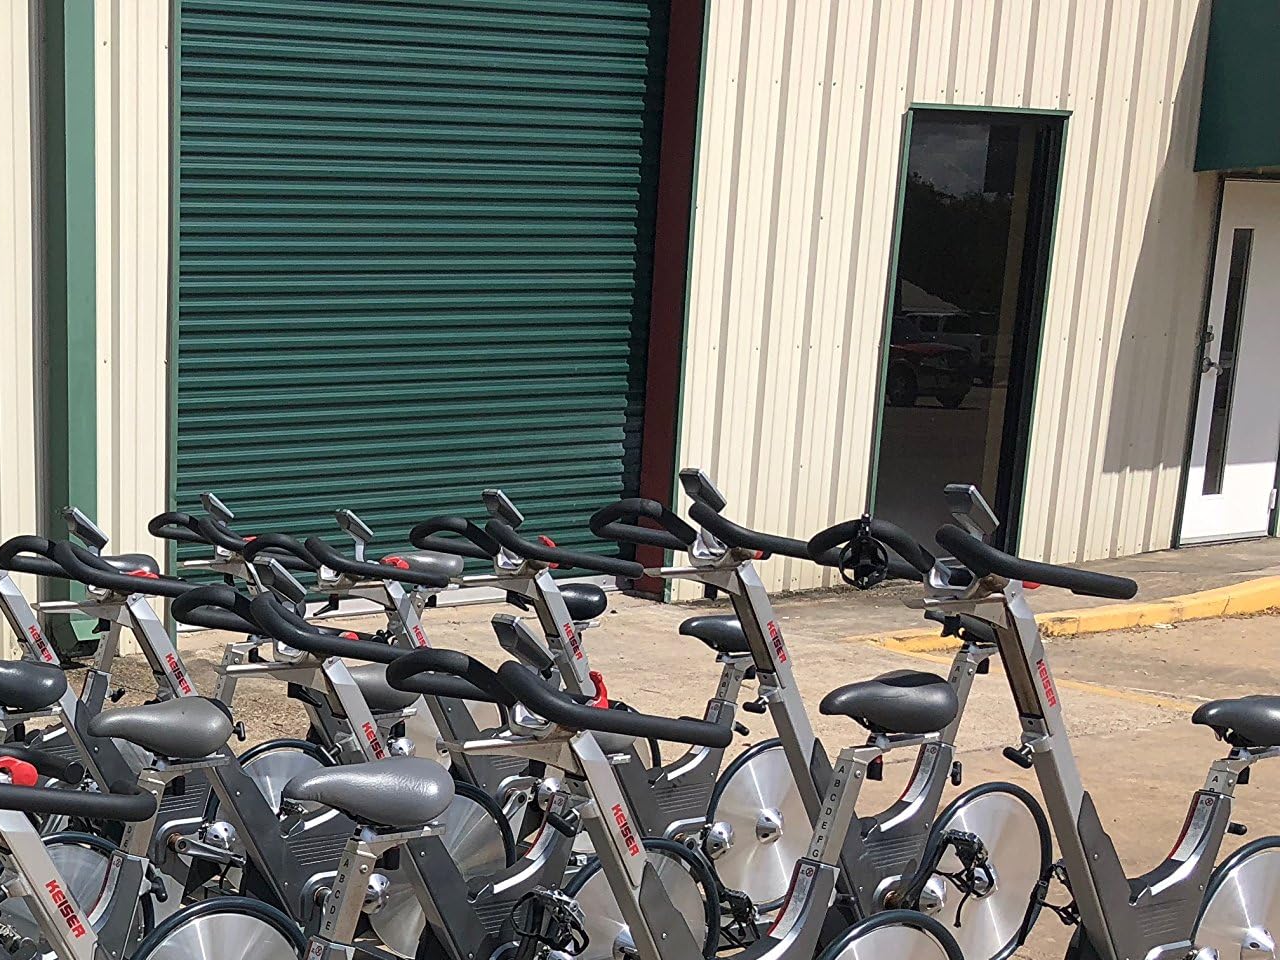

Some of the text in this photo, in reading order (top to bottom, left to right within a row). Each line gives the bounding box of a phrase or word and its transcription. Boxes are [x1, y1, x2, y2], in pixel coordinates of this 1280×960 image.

[28, 624, 53, 663] KEISER
[563, 622, 584, 661] KEISER
[767, 620, 787, 664] KEISER
[165, 652, 192, 695] KEISER
[1036, 658, 1057, 708] KEISER
[361, 721, 386, 760] KEISE
[834, 779, 841, 788] B
[838, 765, 845, 774] A
[825, 807, 832, 816] D
[830, 793, 837, 802] C
[610, 803, 640, 857] KEISER
[821, 821, 828, 830] E
[45, 879, 88, 939] KEISER
